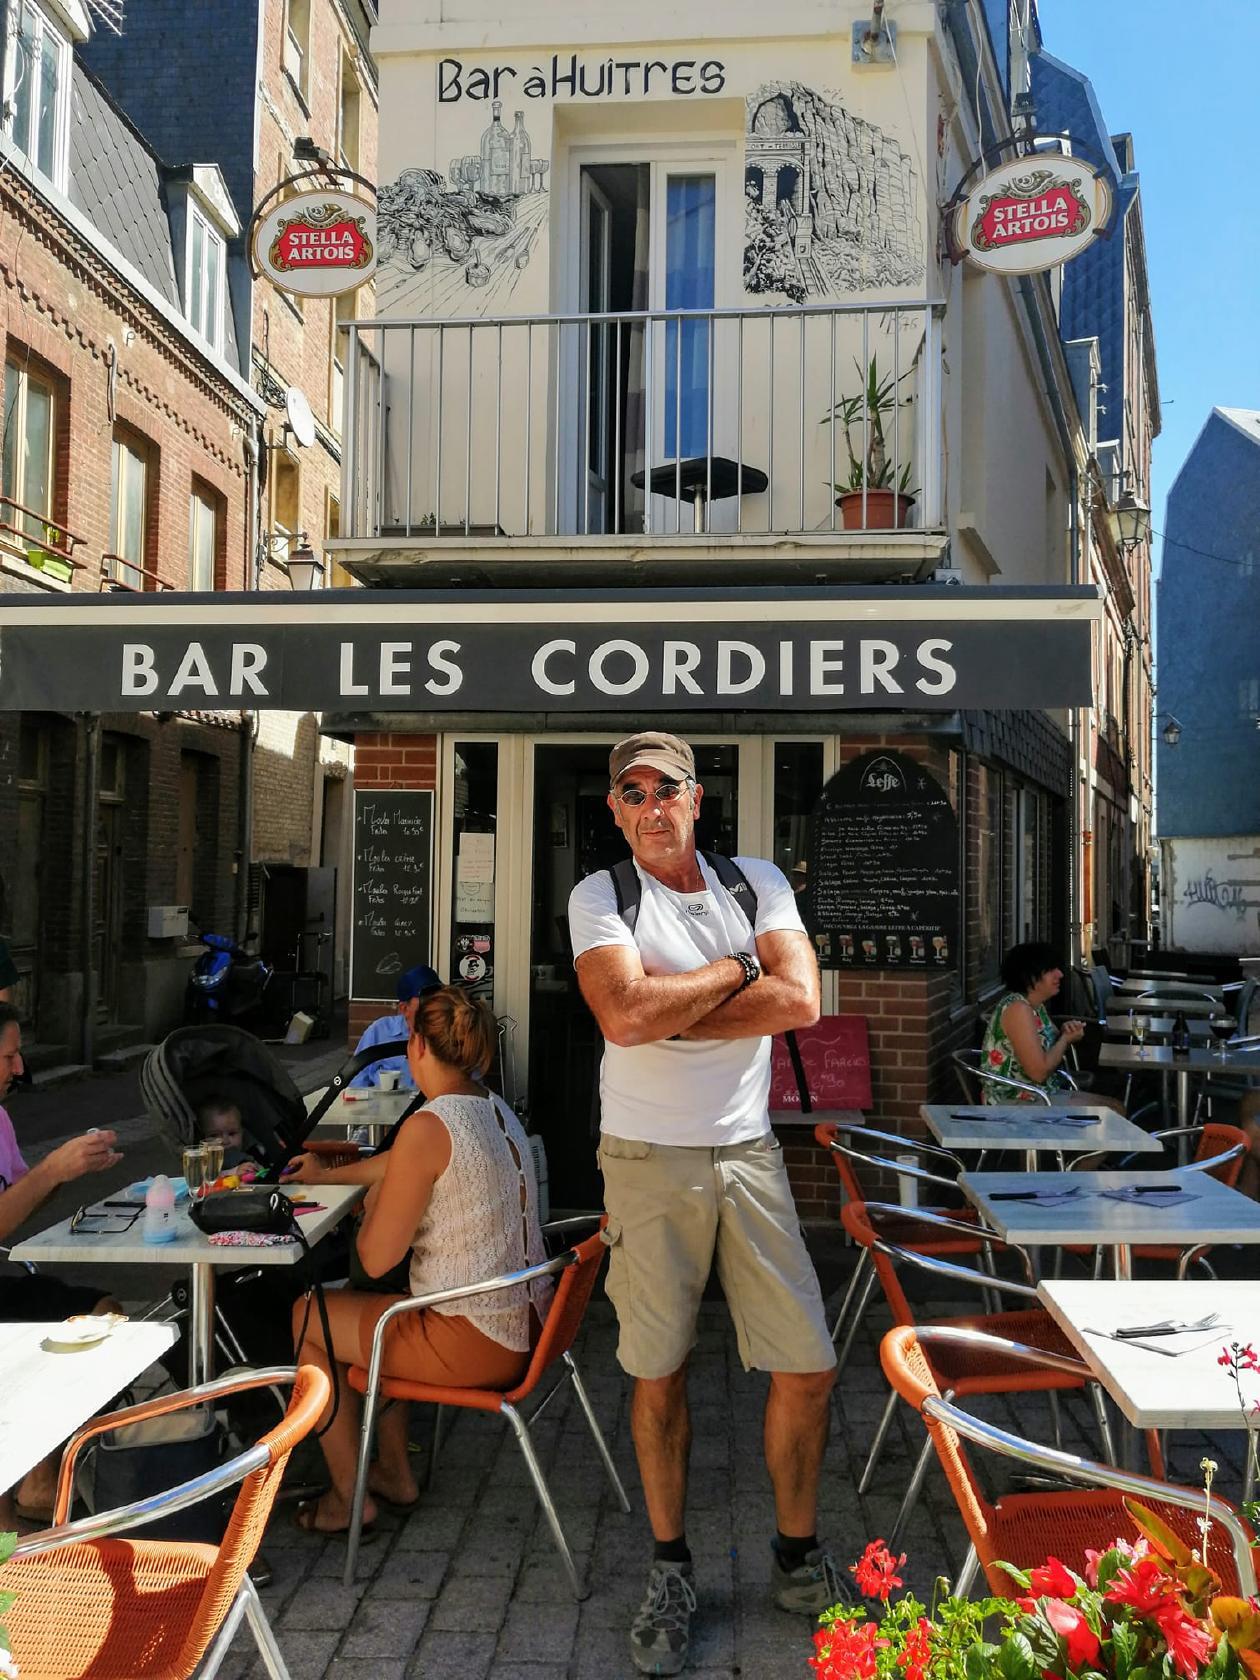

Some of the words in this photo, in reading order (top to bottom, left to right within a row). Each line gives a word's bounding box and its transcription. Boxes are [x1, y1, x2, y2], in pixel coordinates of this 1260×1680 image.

[438, 58, 517, 102] Bar
[523, 66, 546, 98] à
[993, 197, 1068, 222] STELLA
[289, 231, 354, 246] STELLA
[992, 213, 1069, 239] ARTOIS
[288, 246, 354, 260] ARTOIS
[121, 642, 269, 696] BAR
[339, 640, 463, 696] LES
[531, 638, 957, 696] CORDIERS
[866, 773, 900, 792] Leffe
